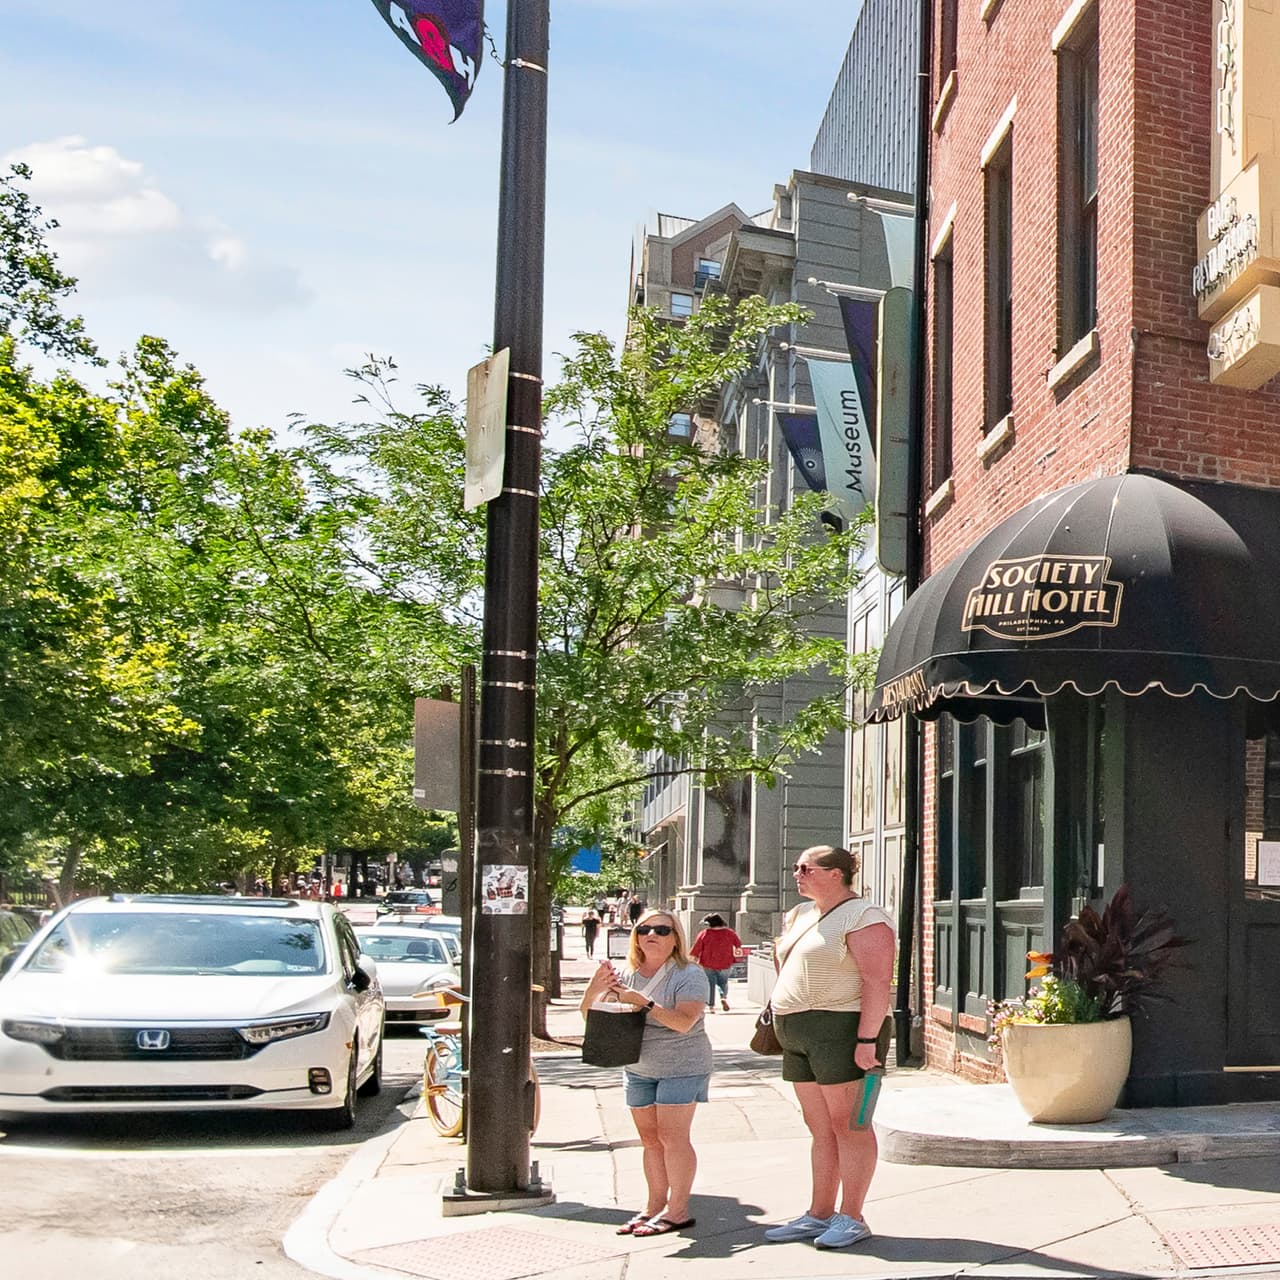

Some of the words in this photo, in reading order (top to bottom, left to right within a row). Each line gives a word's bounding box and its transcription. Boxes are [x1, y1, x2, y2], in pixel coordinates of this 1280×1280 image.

[840, 390, 862, 493] Museum
[986, 562, 1100, 588] SOCIETY
[968, 592, 1015, 618] HILL
[1021, 589, 1110, 614] HOTEL
